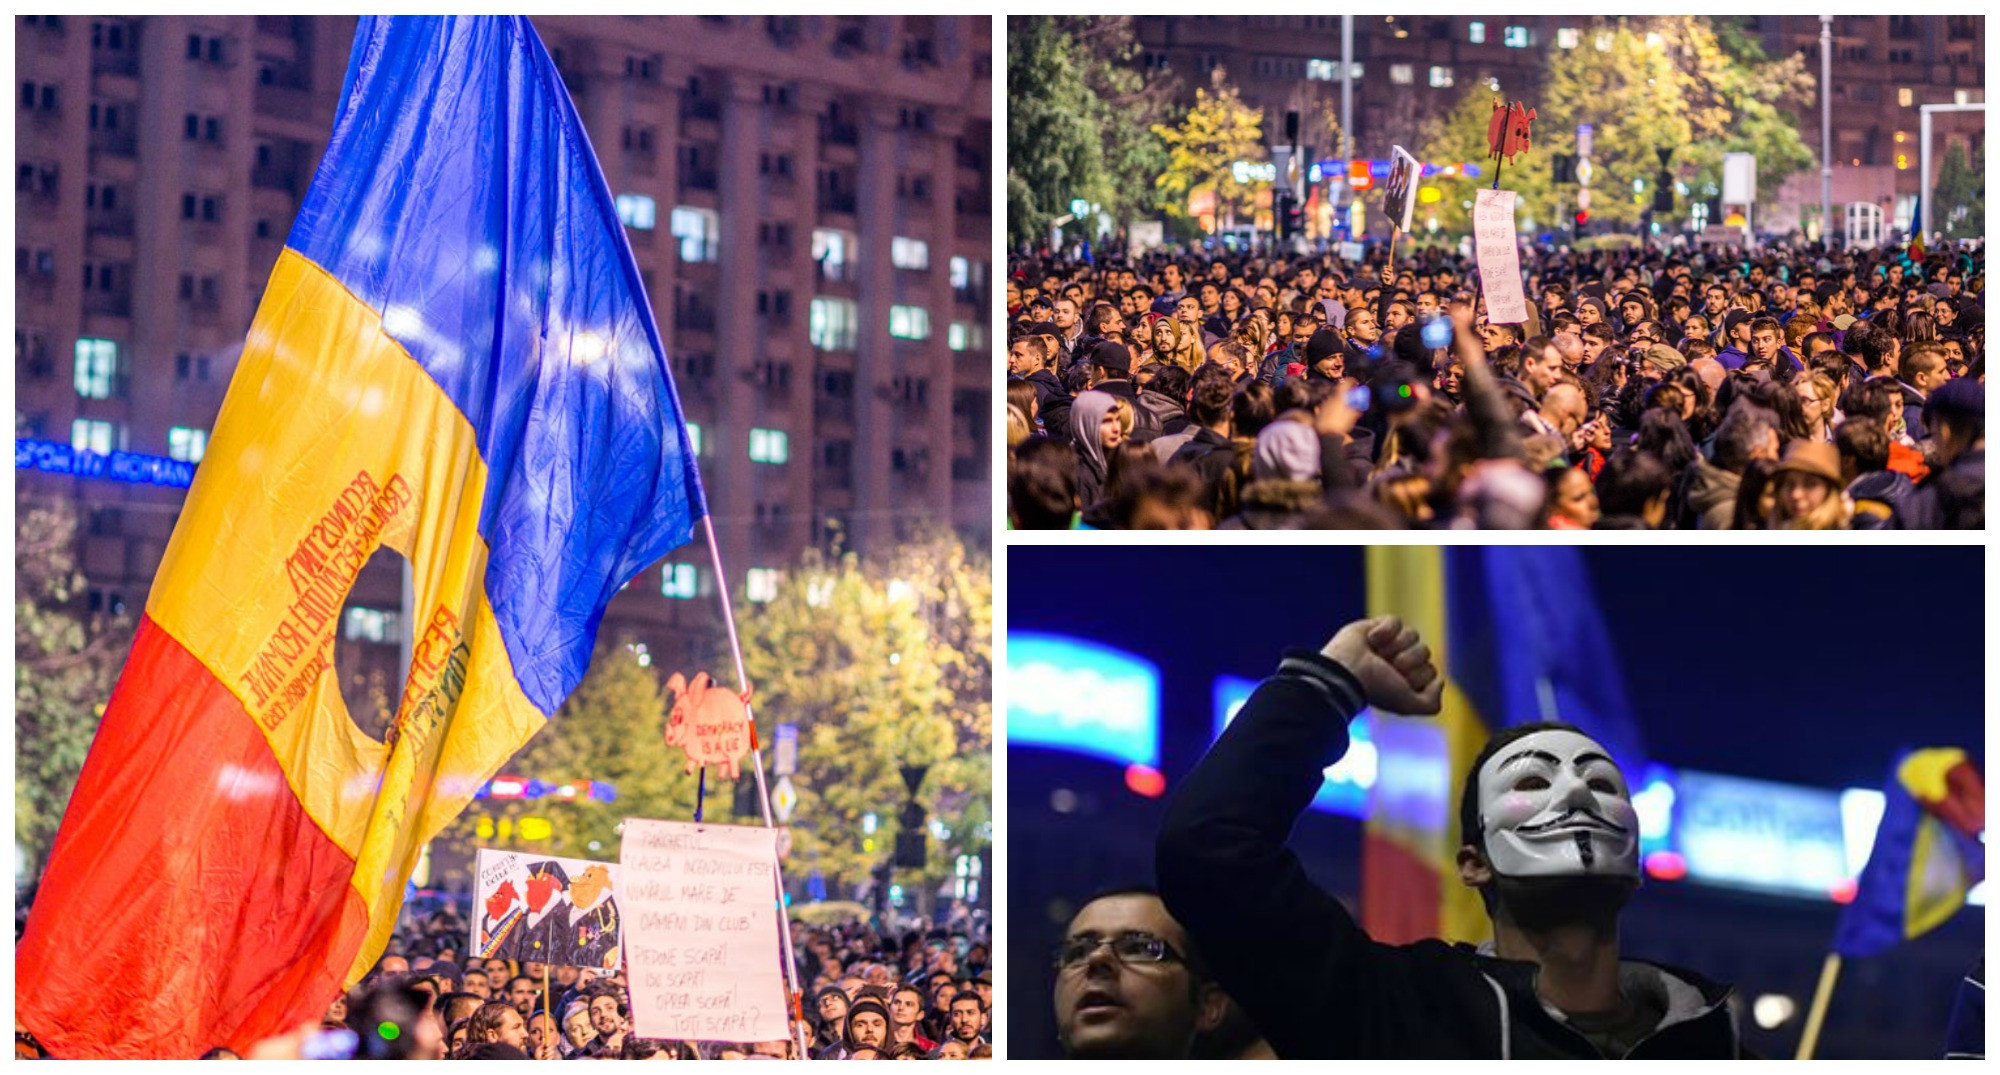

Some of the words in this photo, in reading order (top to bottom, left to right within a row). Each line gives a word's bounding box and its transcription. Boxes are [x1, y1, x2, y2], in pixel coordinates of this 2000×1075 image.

[696, 721, 744, 736] DEMOCRACY
[702, 742, 711, 754] IS
[715, 742, 721, 753] A
[726, 738, 739, 752] LIE
